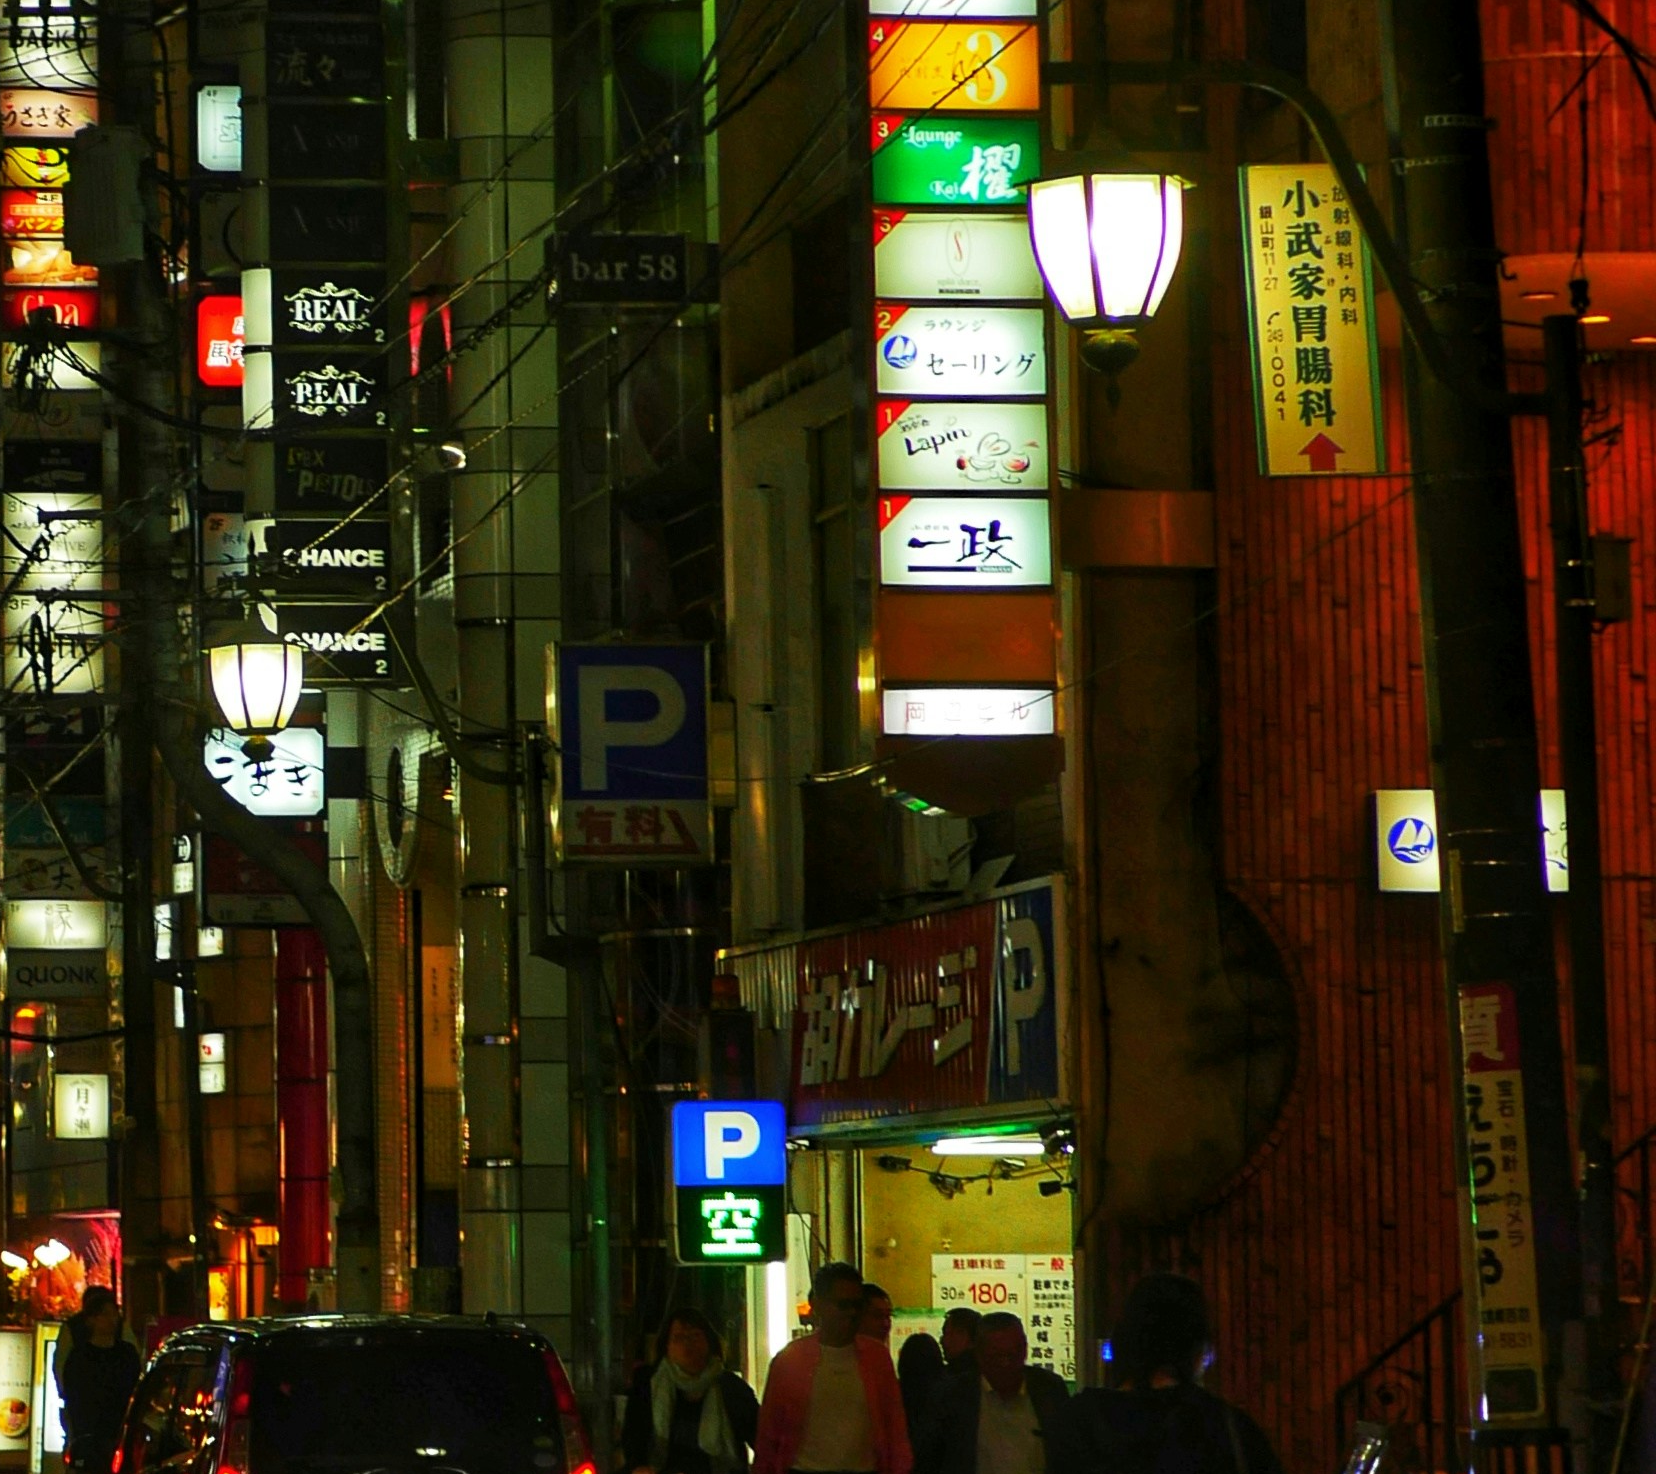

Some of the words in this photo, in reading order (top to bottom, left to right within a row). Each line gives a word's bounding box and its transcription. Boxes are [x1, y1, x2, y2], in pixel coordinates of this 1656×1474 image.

[873, 28, 884, 42] 4
[878, 122, 890, 137] 3
[571, 252, 628, 283] bar
[639, 255, 678, 282] 58
[294, 299, 365, 322] REAL
[1282, 180, 1336, 427] 小武家胃腸科
[875, 312, 892, 329] 2
[375, 328, 386, 343] 2
[927, 352, 1037, 377] セーリング
[295, 382, 369, 406] REAL
[376, 411, 387, 426] 2
[884, 408, 893, 424] 1
[904, 429, 970, 456] Lapin
[884, 500, 893, 518] 1
[907, 520, 1023, 569] 一政
[375, 576, 387, 590] 2
[9, 599, 30, 610] 3F
[375, 659, 388, 675] 2
[578, 664, 687, 791] P
[1004, 917, 1046, 1076] P
[704, 1111, 762, 1180] P
[701, 1191, 762, 1256] 空
[1032, 1257, 1074, 1271] 一般
[1034, 1280, 1074, 1291] 駐車でき
